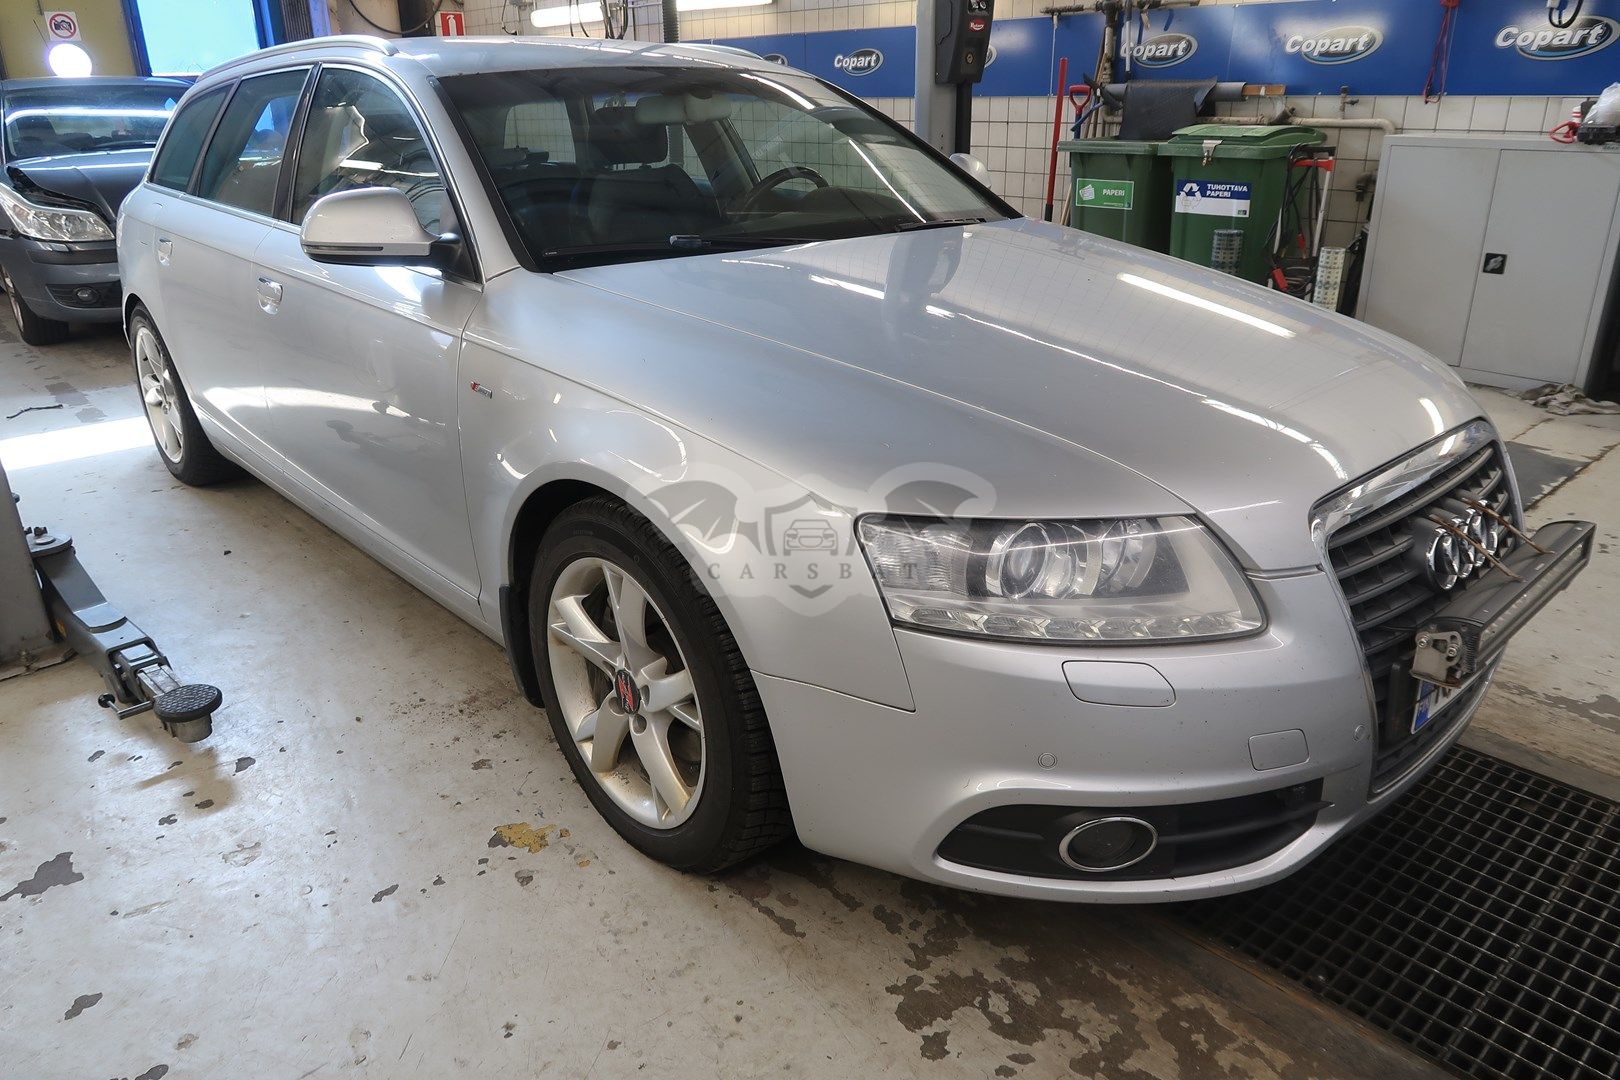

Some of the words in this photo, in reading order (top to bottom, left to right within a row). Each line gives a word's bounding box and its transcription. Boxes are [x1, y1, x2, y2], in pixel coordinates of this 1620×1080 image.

[1285, 32, 1370, 56] Copart
[1496, 23, 1604, 51] Copart
[1120, 40, 1187, 60] Copart
[834, 53, 878, 70] Copart
[1102, 188, 1125, 196] PAPERI
[1206, 183, 1248, 192] TUHOTTAVA
[1206, 190, 1231, 198] PAPERI
